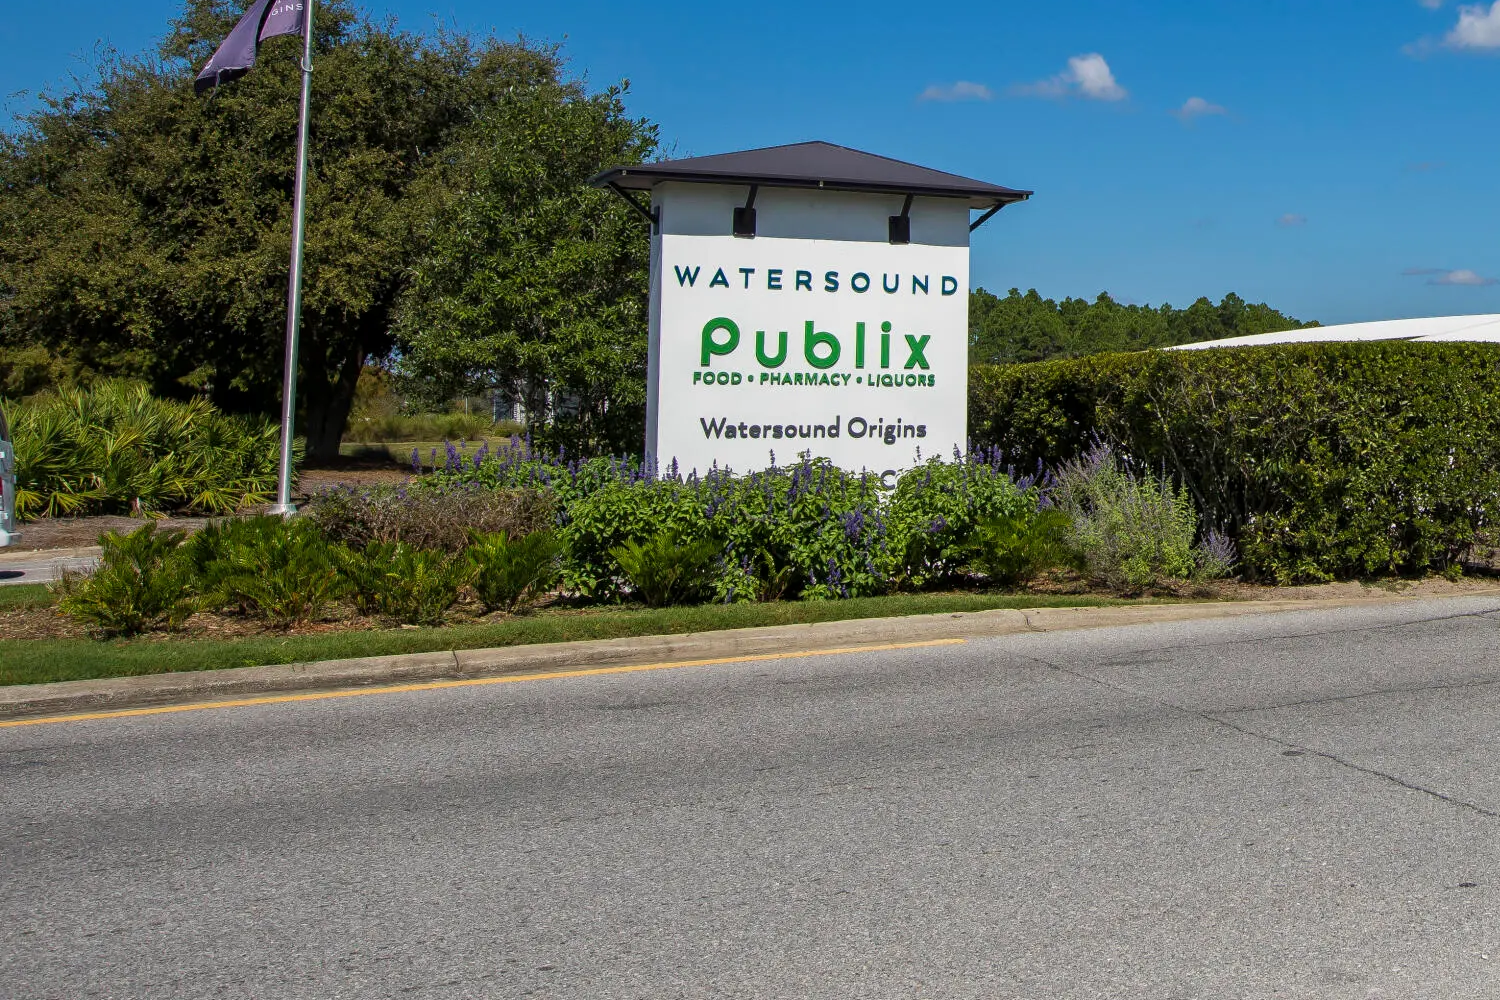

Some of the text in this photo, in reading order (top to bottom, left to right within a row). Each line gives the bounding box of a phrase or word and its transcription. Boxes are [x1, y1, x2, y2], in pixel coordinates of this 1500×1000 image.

[674, 265, 958, 296] WATERSOUND
[700, 316, 931, 370] Publix
[692, 371, 935, 388] FOOD PHARMACY LIQUORS
[700, 415, 927, 445] Watersound Origins
